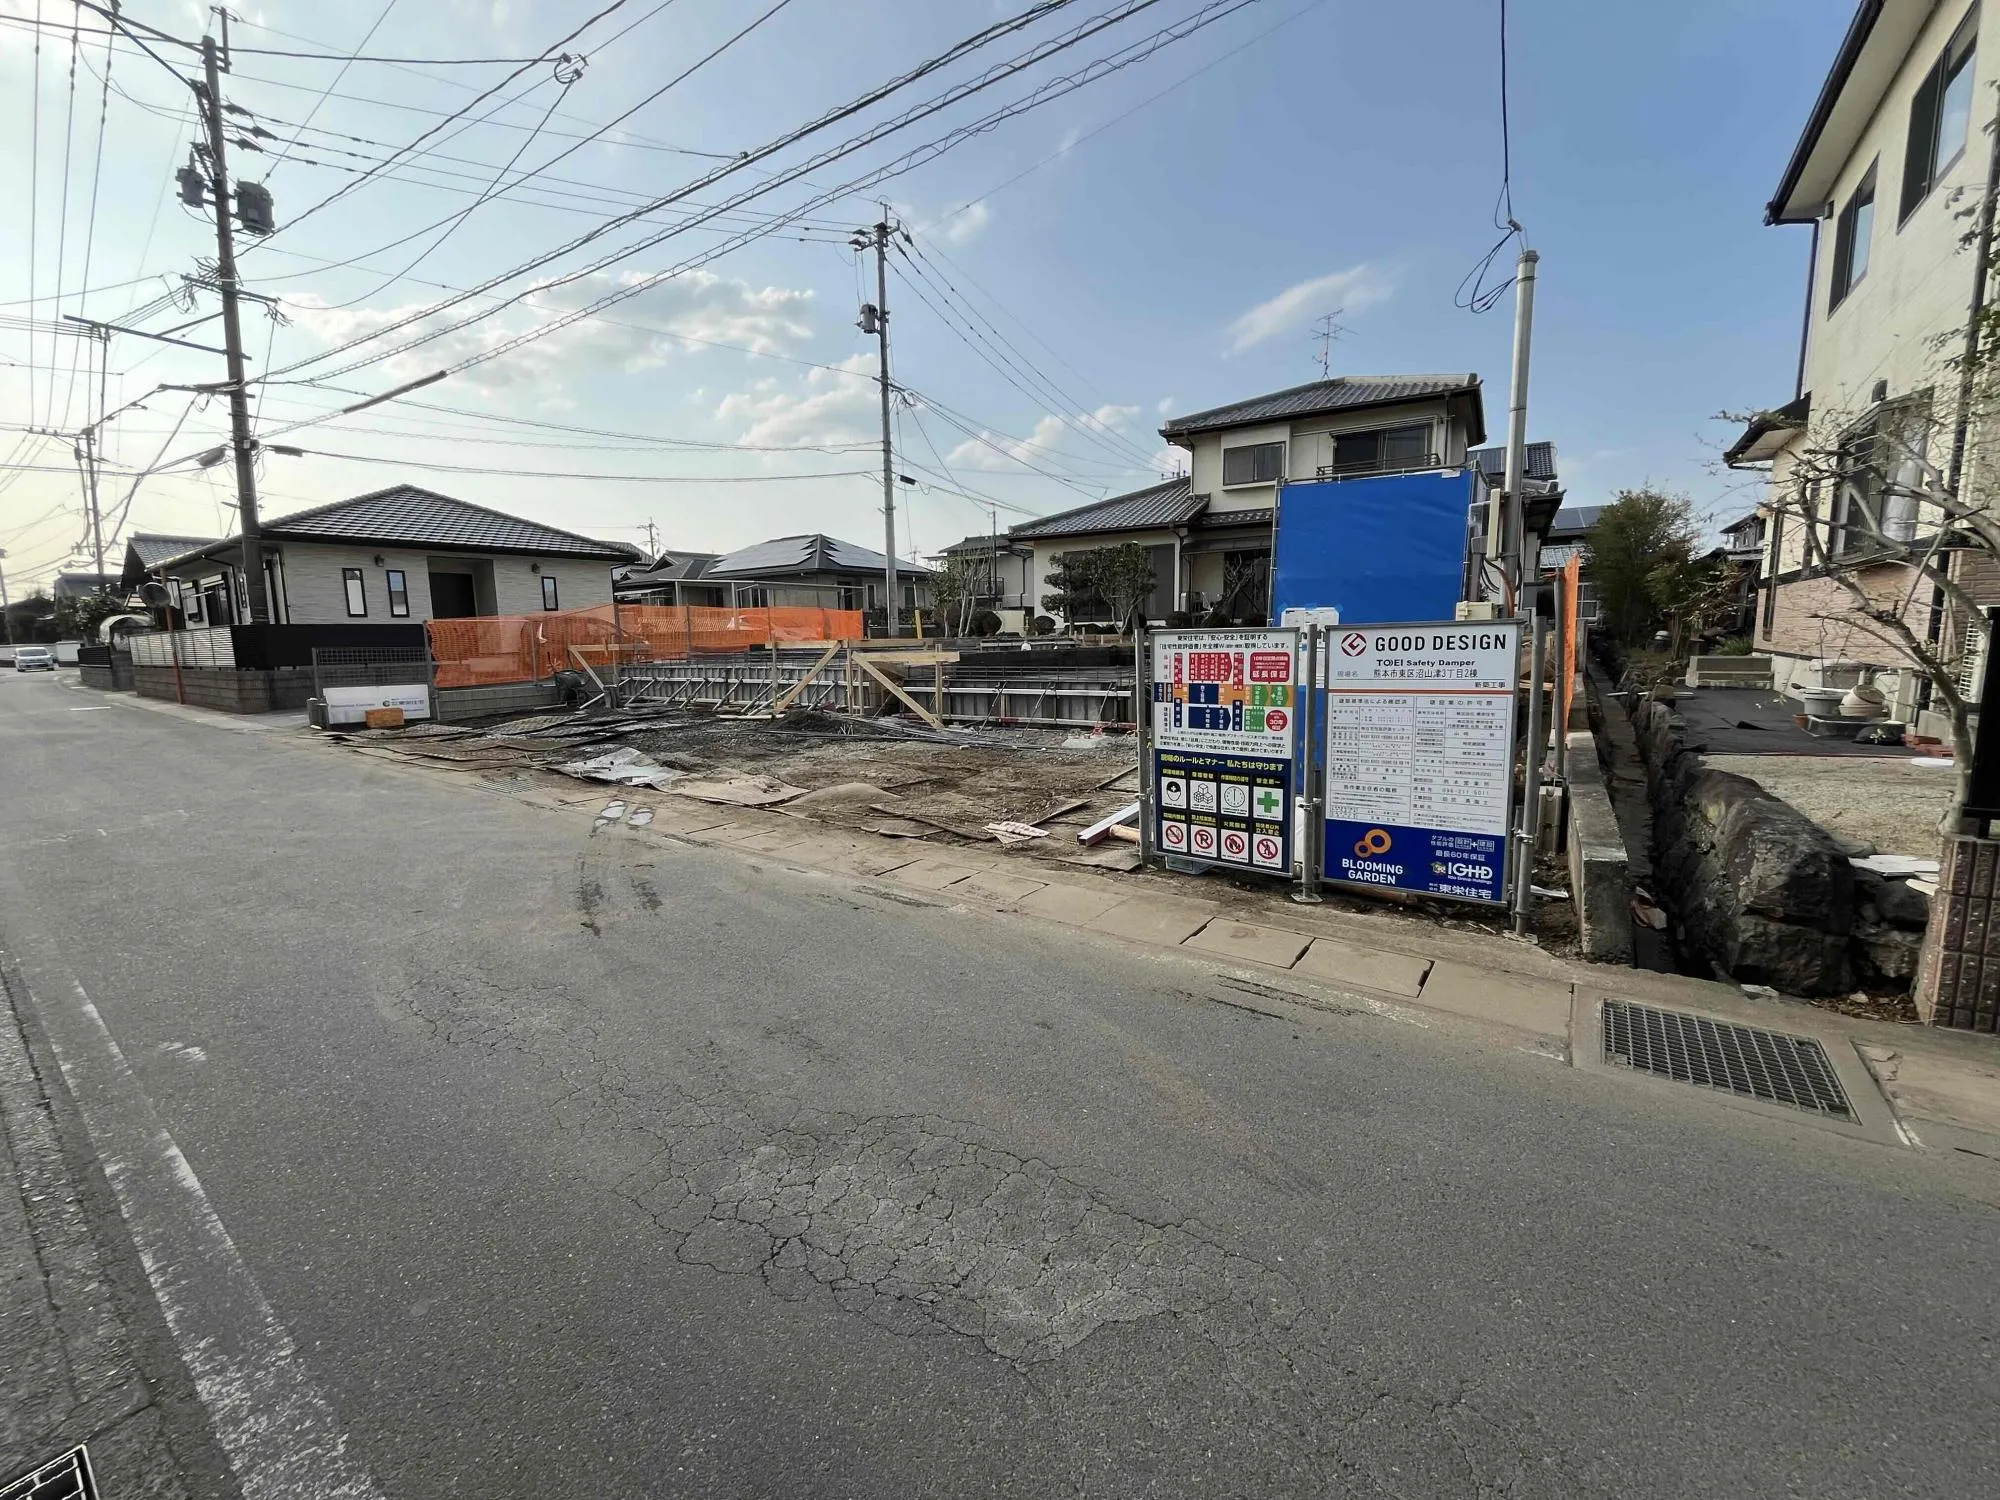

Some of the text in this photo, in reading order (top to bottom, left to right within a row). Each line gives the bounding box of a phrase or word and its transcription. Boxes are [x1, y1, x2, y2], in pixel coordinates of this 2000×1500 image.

[1375, 634, 1506, 651] GOOD DESIGN
[1406, 659, 1436, 668] Safety
[1438, 659, 1476, 668] Damper
[1226, 759, 1285, 772] 私たちは守ります
[1435, 850, 1486, 862] 最長60年保証
[1341, 858, 1404, 875] BLOOMING
[1348, 869, 1396, 885] GARDEN
[1438, 884, 1492, 900] 東栄住宅
